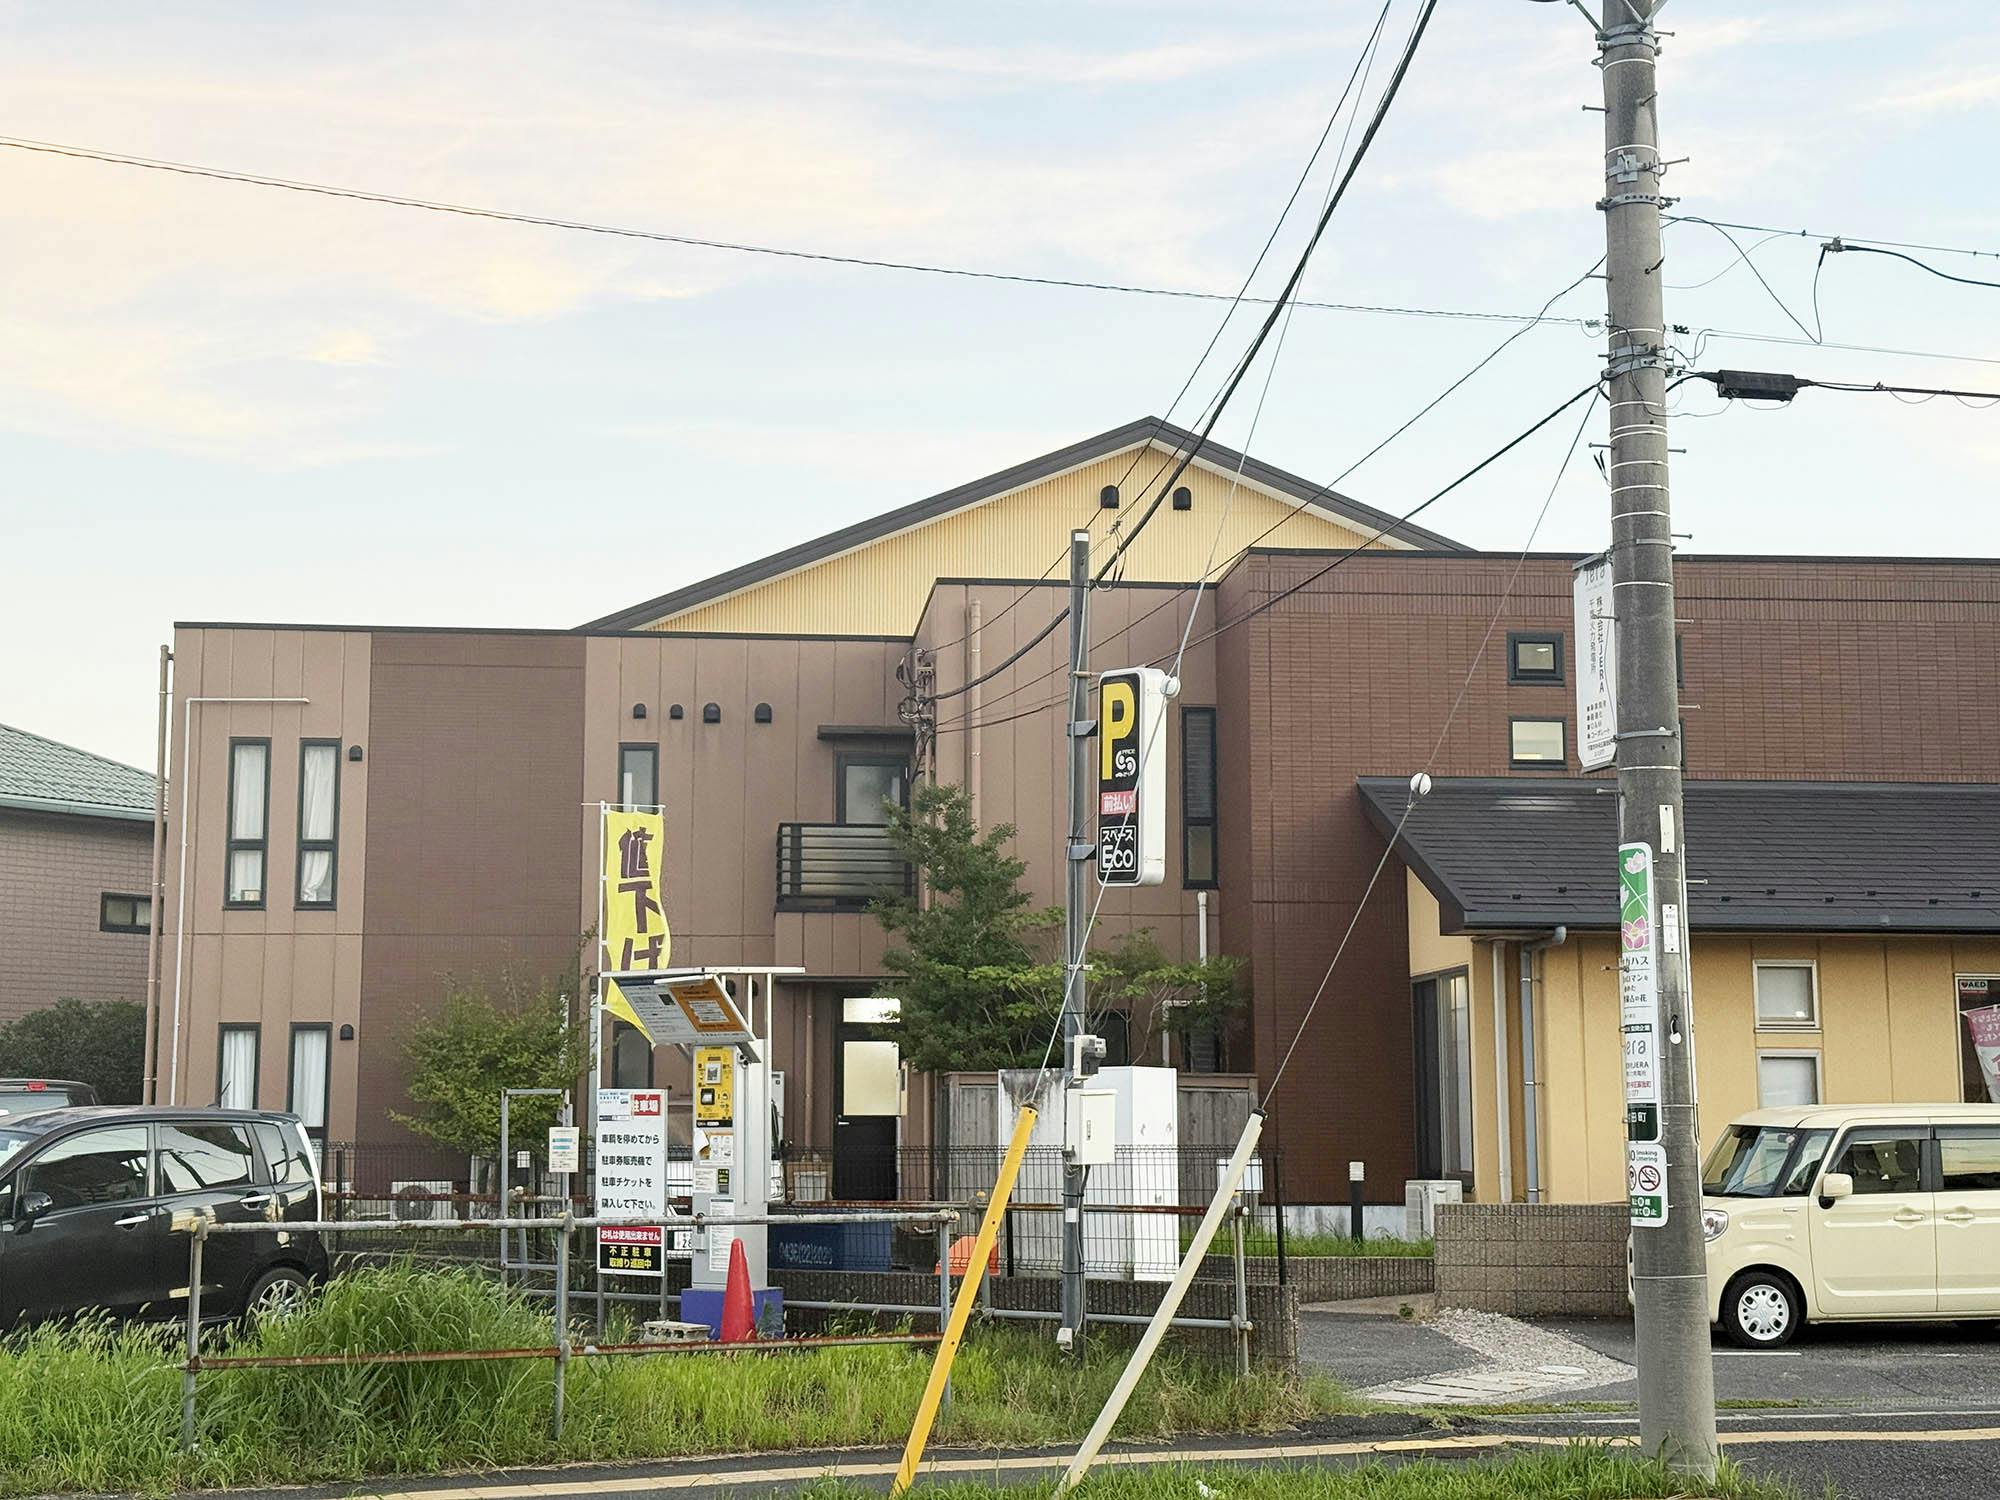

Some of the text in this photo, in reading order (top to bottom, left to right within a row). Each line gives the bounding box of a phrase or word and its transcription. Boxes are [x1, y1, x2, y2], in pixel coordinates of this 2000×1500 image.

[1102, 682, 1135, 779] P
[1103, 794, 1134, 812] 前払い
[1102, 829, 1134, 842] スペース
[1102, 845, 1134, 869] ECO
[601, 1156, 653, 1166] 駐車券販売機で
[601, 1177, 653, 1188] 駐車チケットを
[600, 1230, 661, 1241] お札は使用出来ません
[609, 1246, 652, 1257] 不正駐車
[609, 1258, 652, 1269] 取締り巡回中
